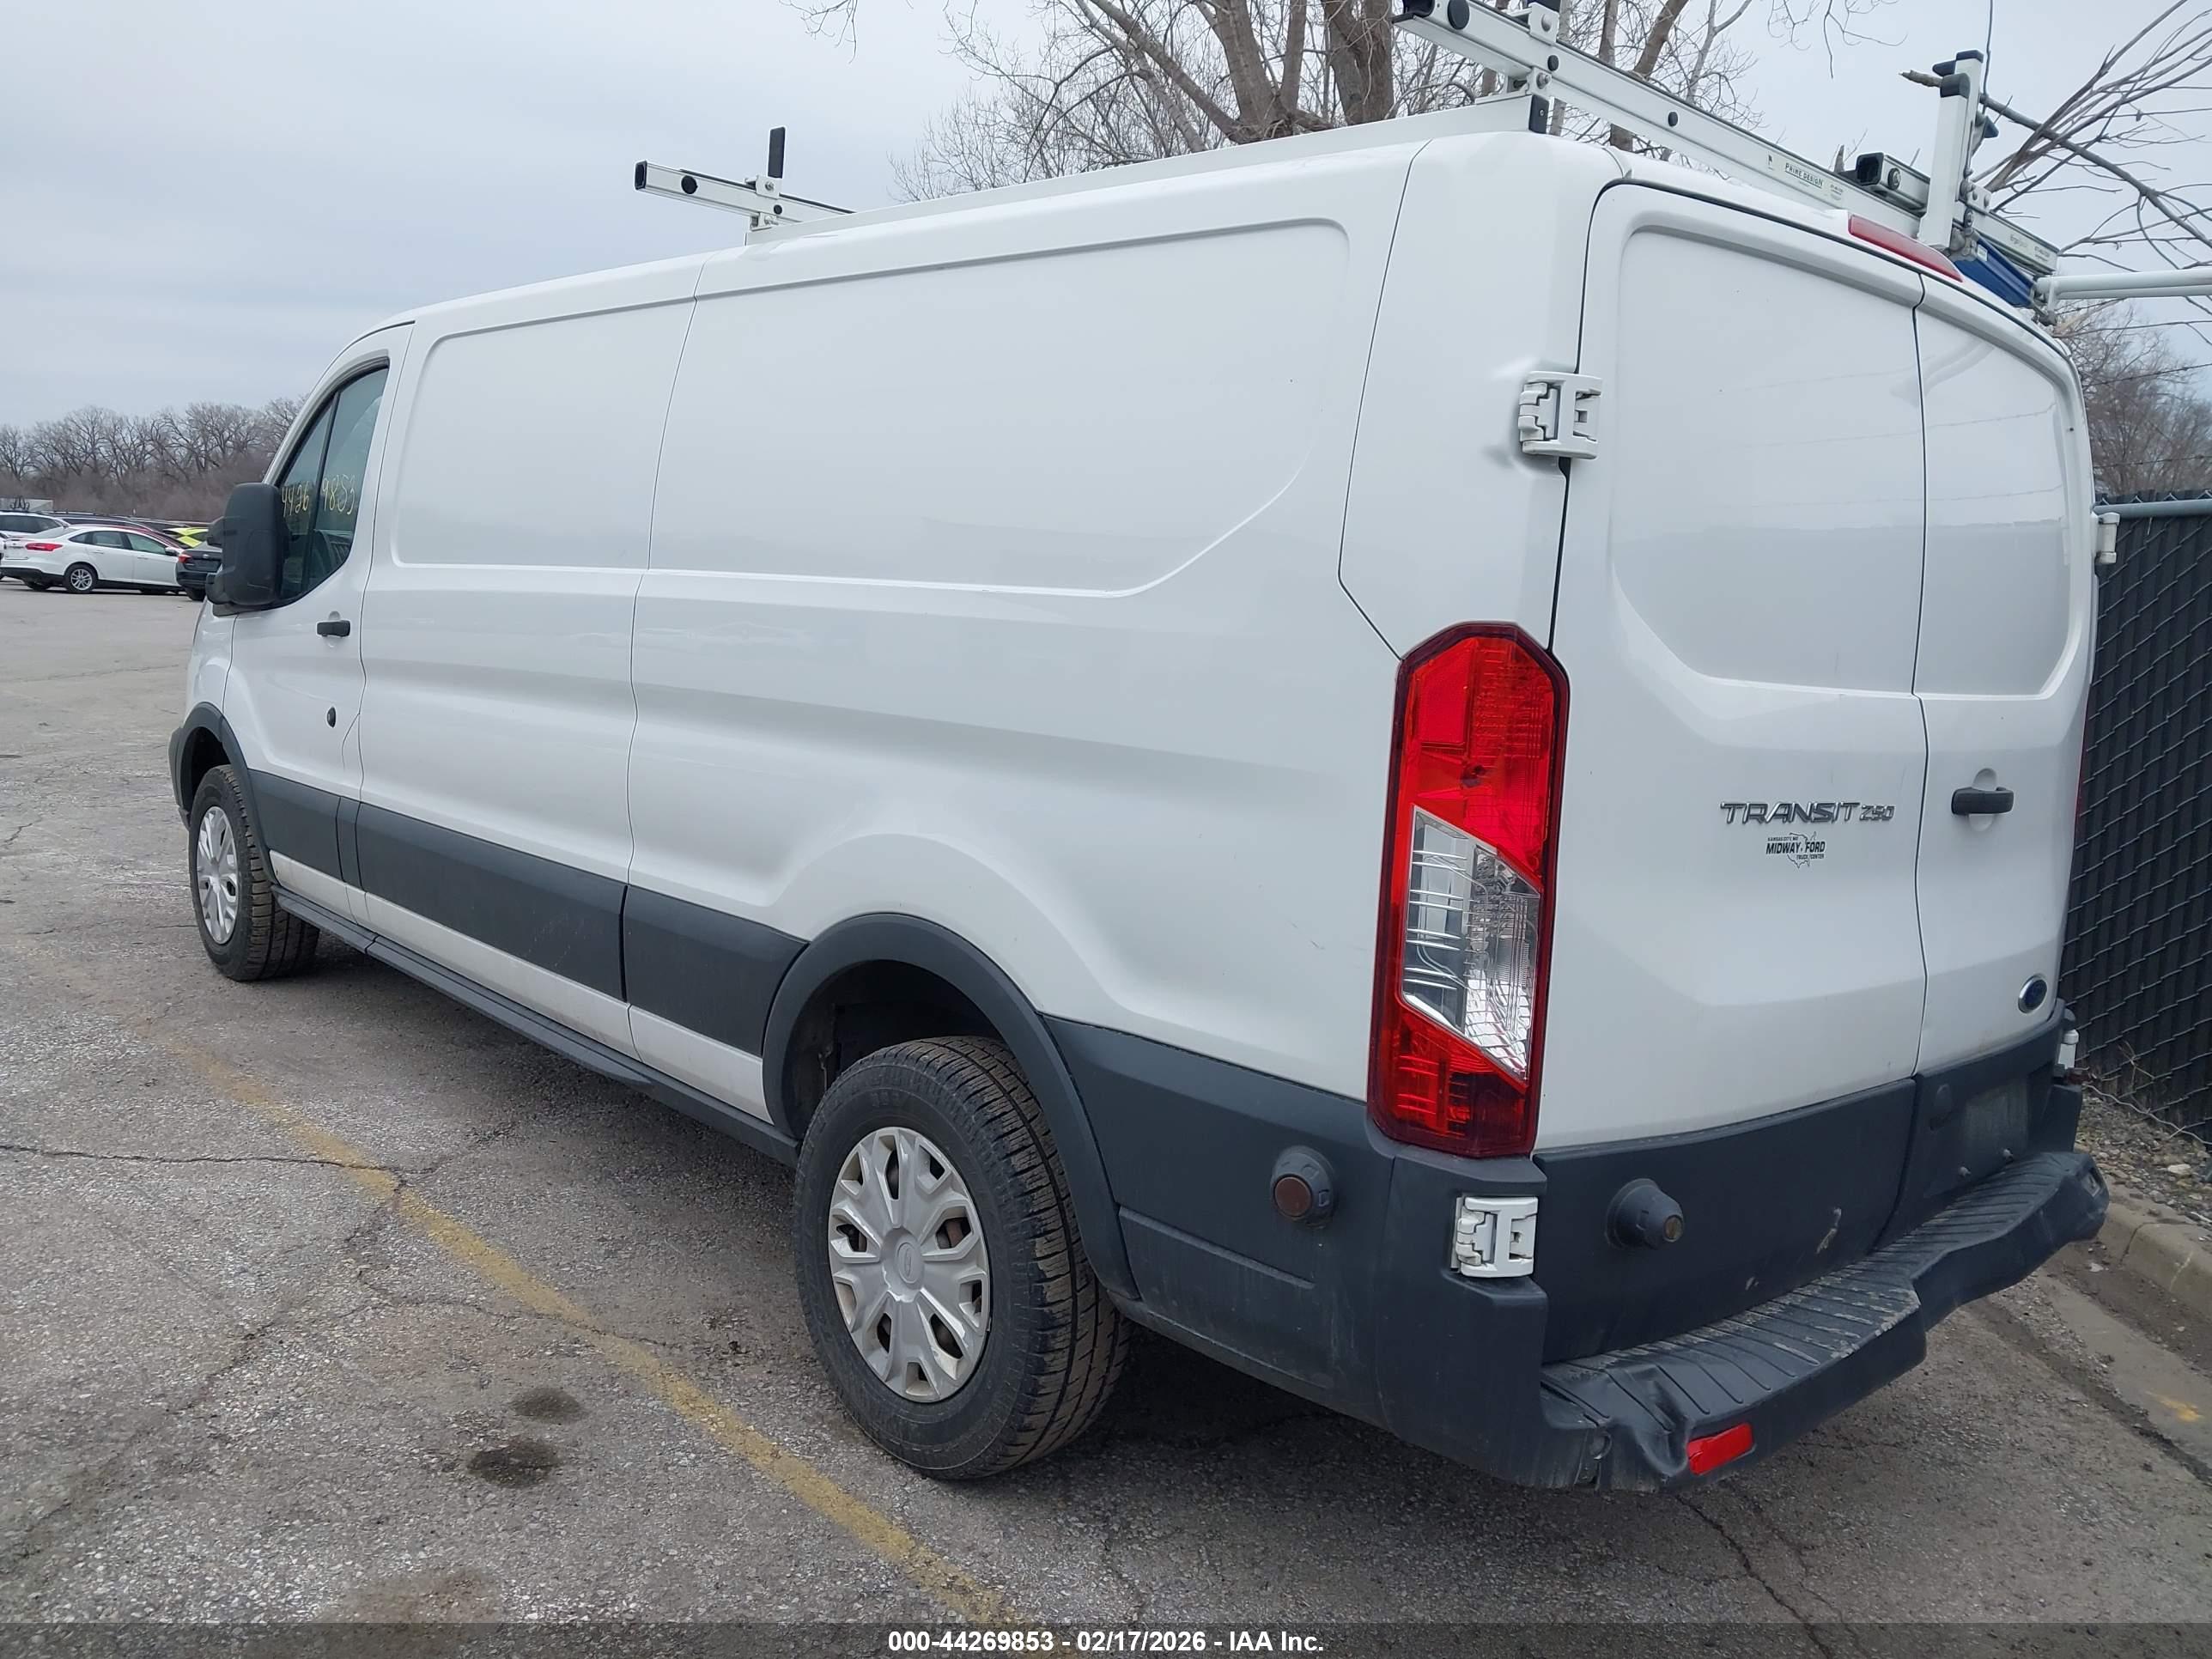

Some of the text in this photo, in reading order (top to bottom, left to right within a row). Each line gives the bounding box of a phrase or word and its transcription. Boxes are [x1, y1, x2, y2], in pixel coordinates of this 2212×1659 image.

[1785, 162, 1802, 177] PRIME
[1803, 173, 1823, 186] DESIGN
[282, 474, 356, 518] 4426 9853
[1720, 802, 1895, 824] TRANSIT 250
[1765, 841, 1826, 854] MIDWAY FORD
